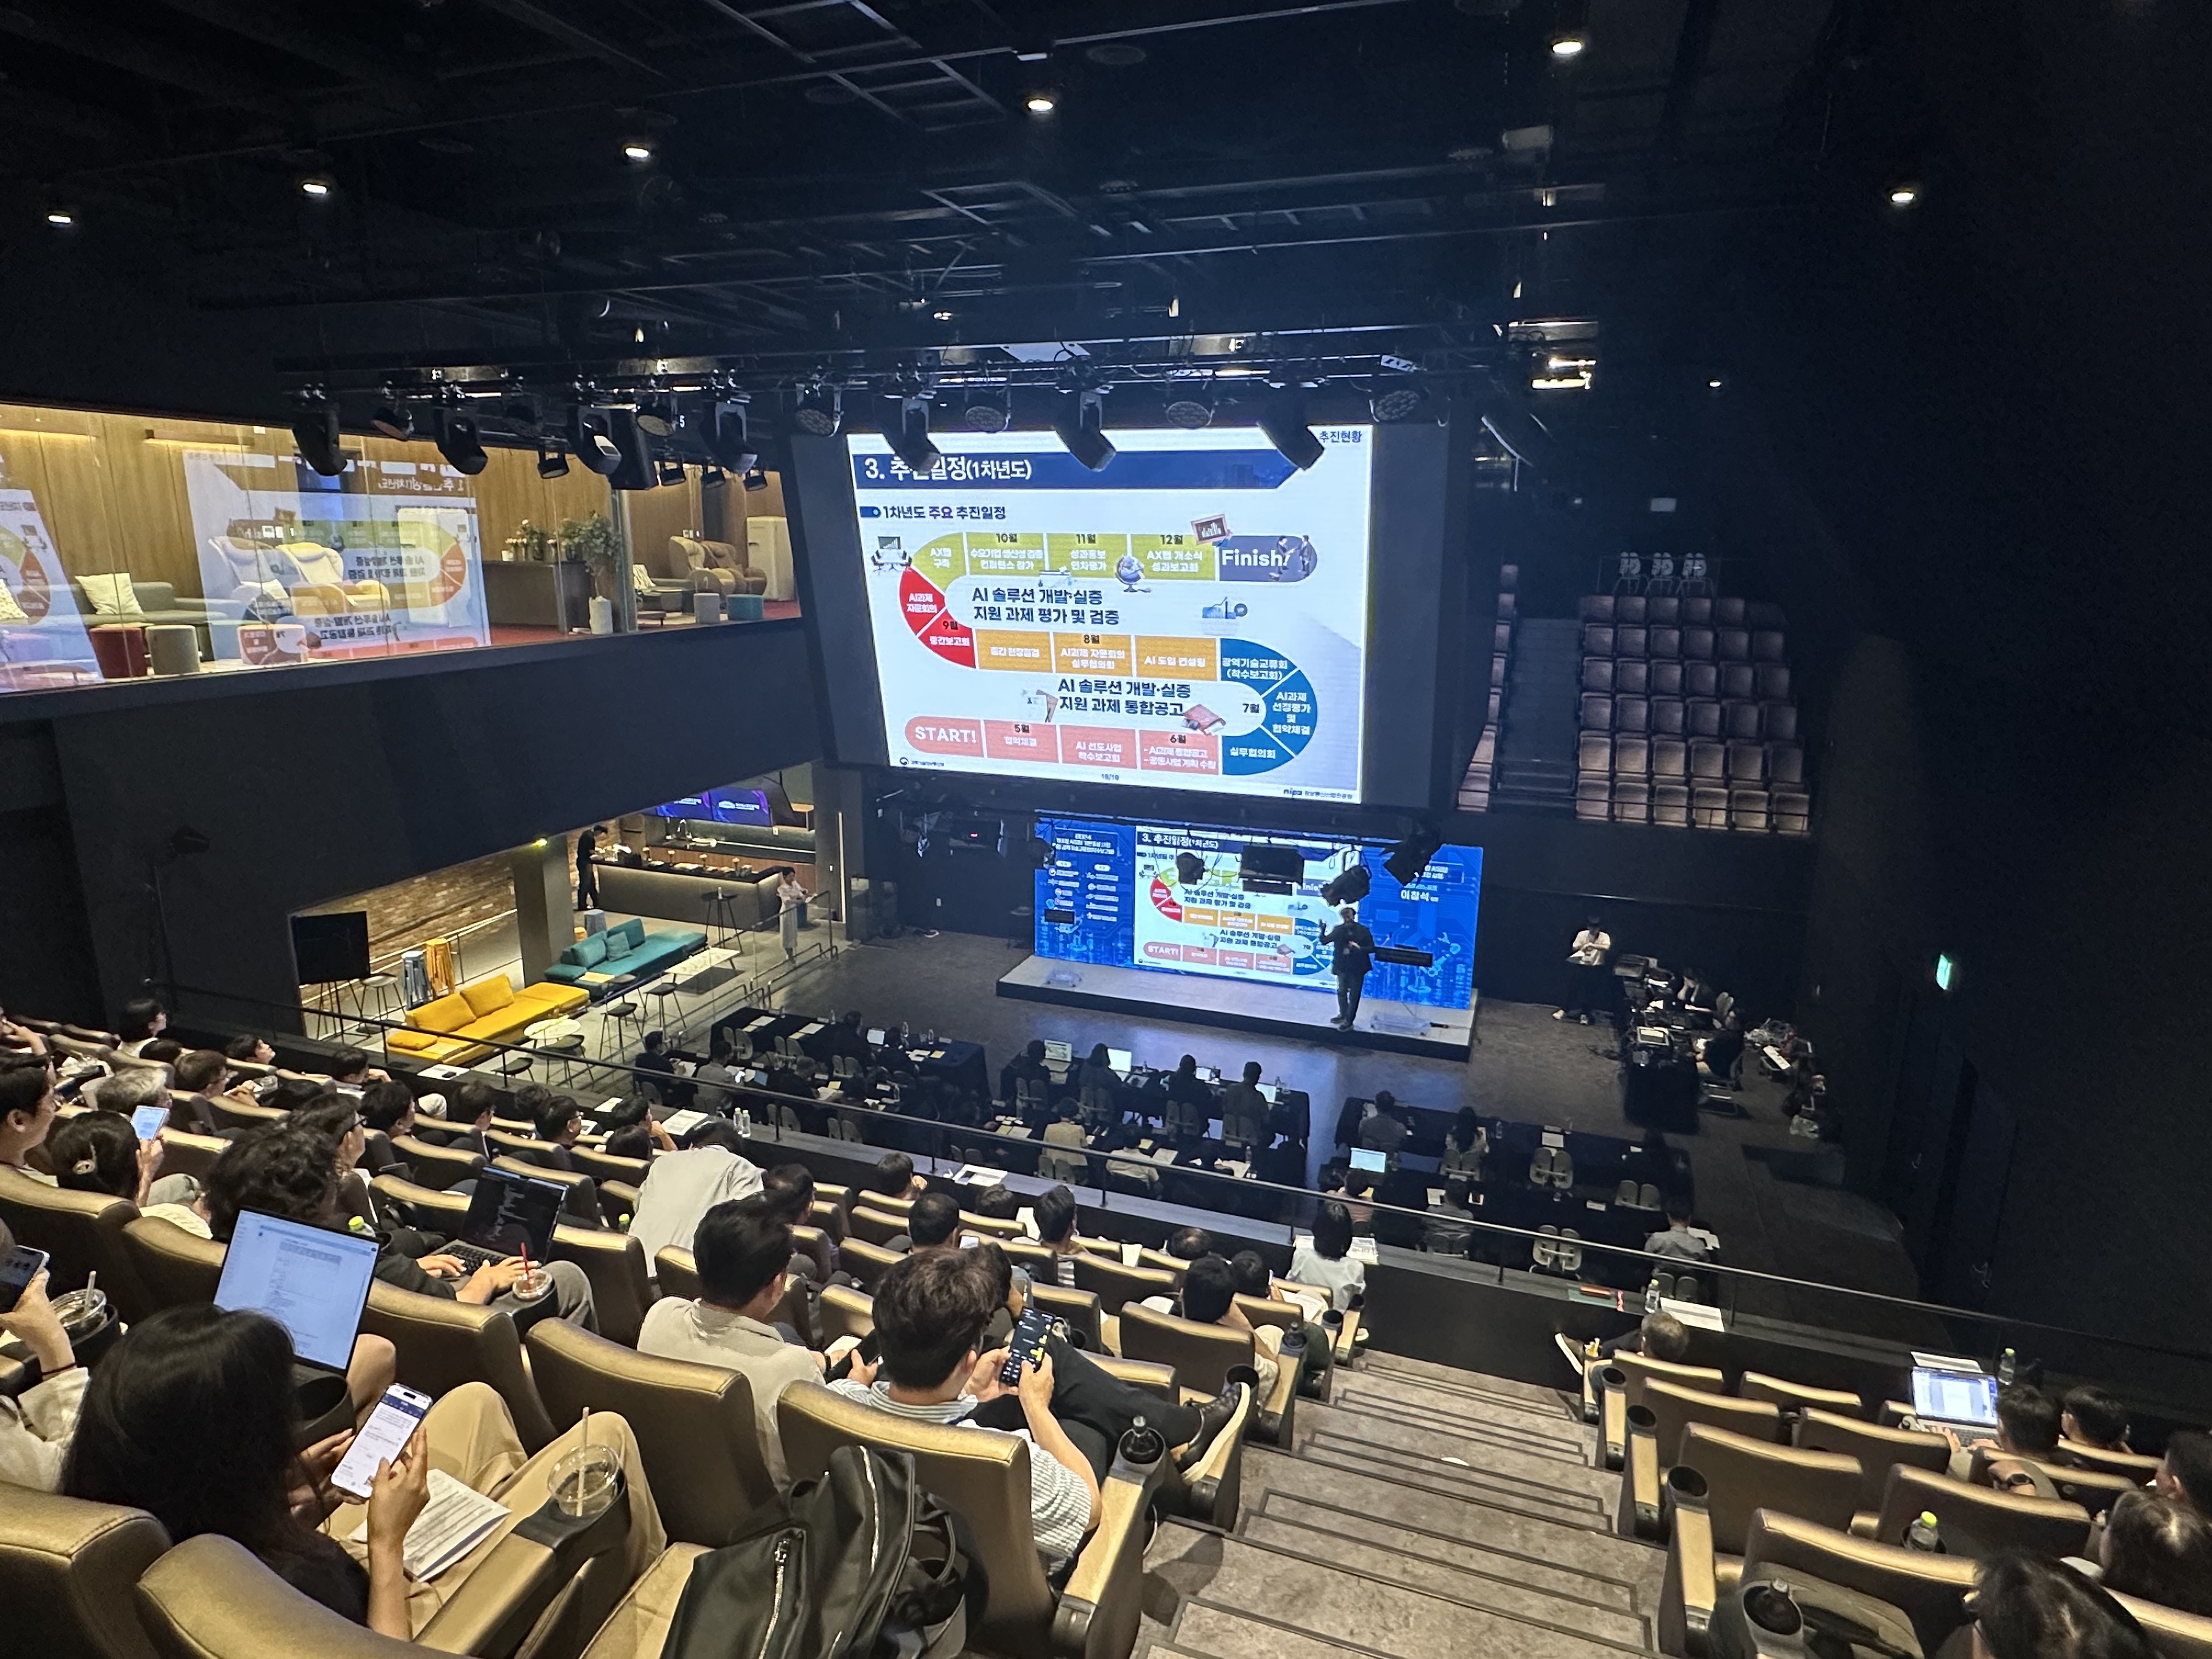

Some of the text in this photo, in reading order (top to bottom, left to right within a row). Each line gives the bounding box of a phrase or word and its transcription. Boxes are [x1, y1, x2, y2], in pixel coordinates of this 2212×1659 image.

[1319, 430, 1363, 443] 추진현황
[865, 456, 1032, 481] 3. 추일정(1차년도)
[883, 506, 1006, 520] 1차년도 주요 추진일정
[995, 533, 1018, 543] 10월
[1076, 534, 1096, 544] 11월
[1160, 534, 1183, 545] 12월
[1221, 549, 1290, 566] Finish!
[972, 588, 988, 601] AI
[992, 588, 1035, 603] 솔루션
[974, 606, 1119, 625] 지원 과제 평가 및 검증
[943, 621, 959, 630] 9월
[1083, 635, 1101, 644] 8월
[1158, 656, 1176, 666] 도입
[1222, 657, 1288, 669] 광역기술교류회
[1227, 669, 1283, 680] (착수보고회)
[1058, 679, 1075, 692] AI
[1079, 679, 1122, 695] 솔루션
[1276, 692, 1307, 702] AI과제
[1060, 697, 1184, 716] 지원 과제 통합공고
[1242, 703, 1260, 714] 7월
[1014, 724, 1030, 733] 5월
[915, 726, 977, 744] START!
[1075, 741, 1086, 750] AI
[1229, 747, 1277, 759] 실무협의회
